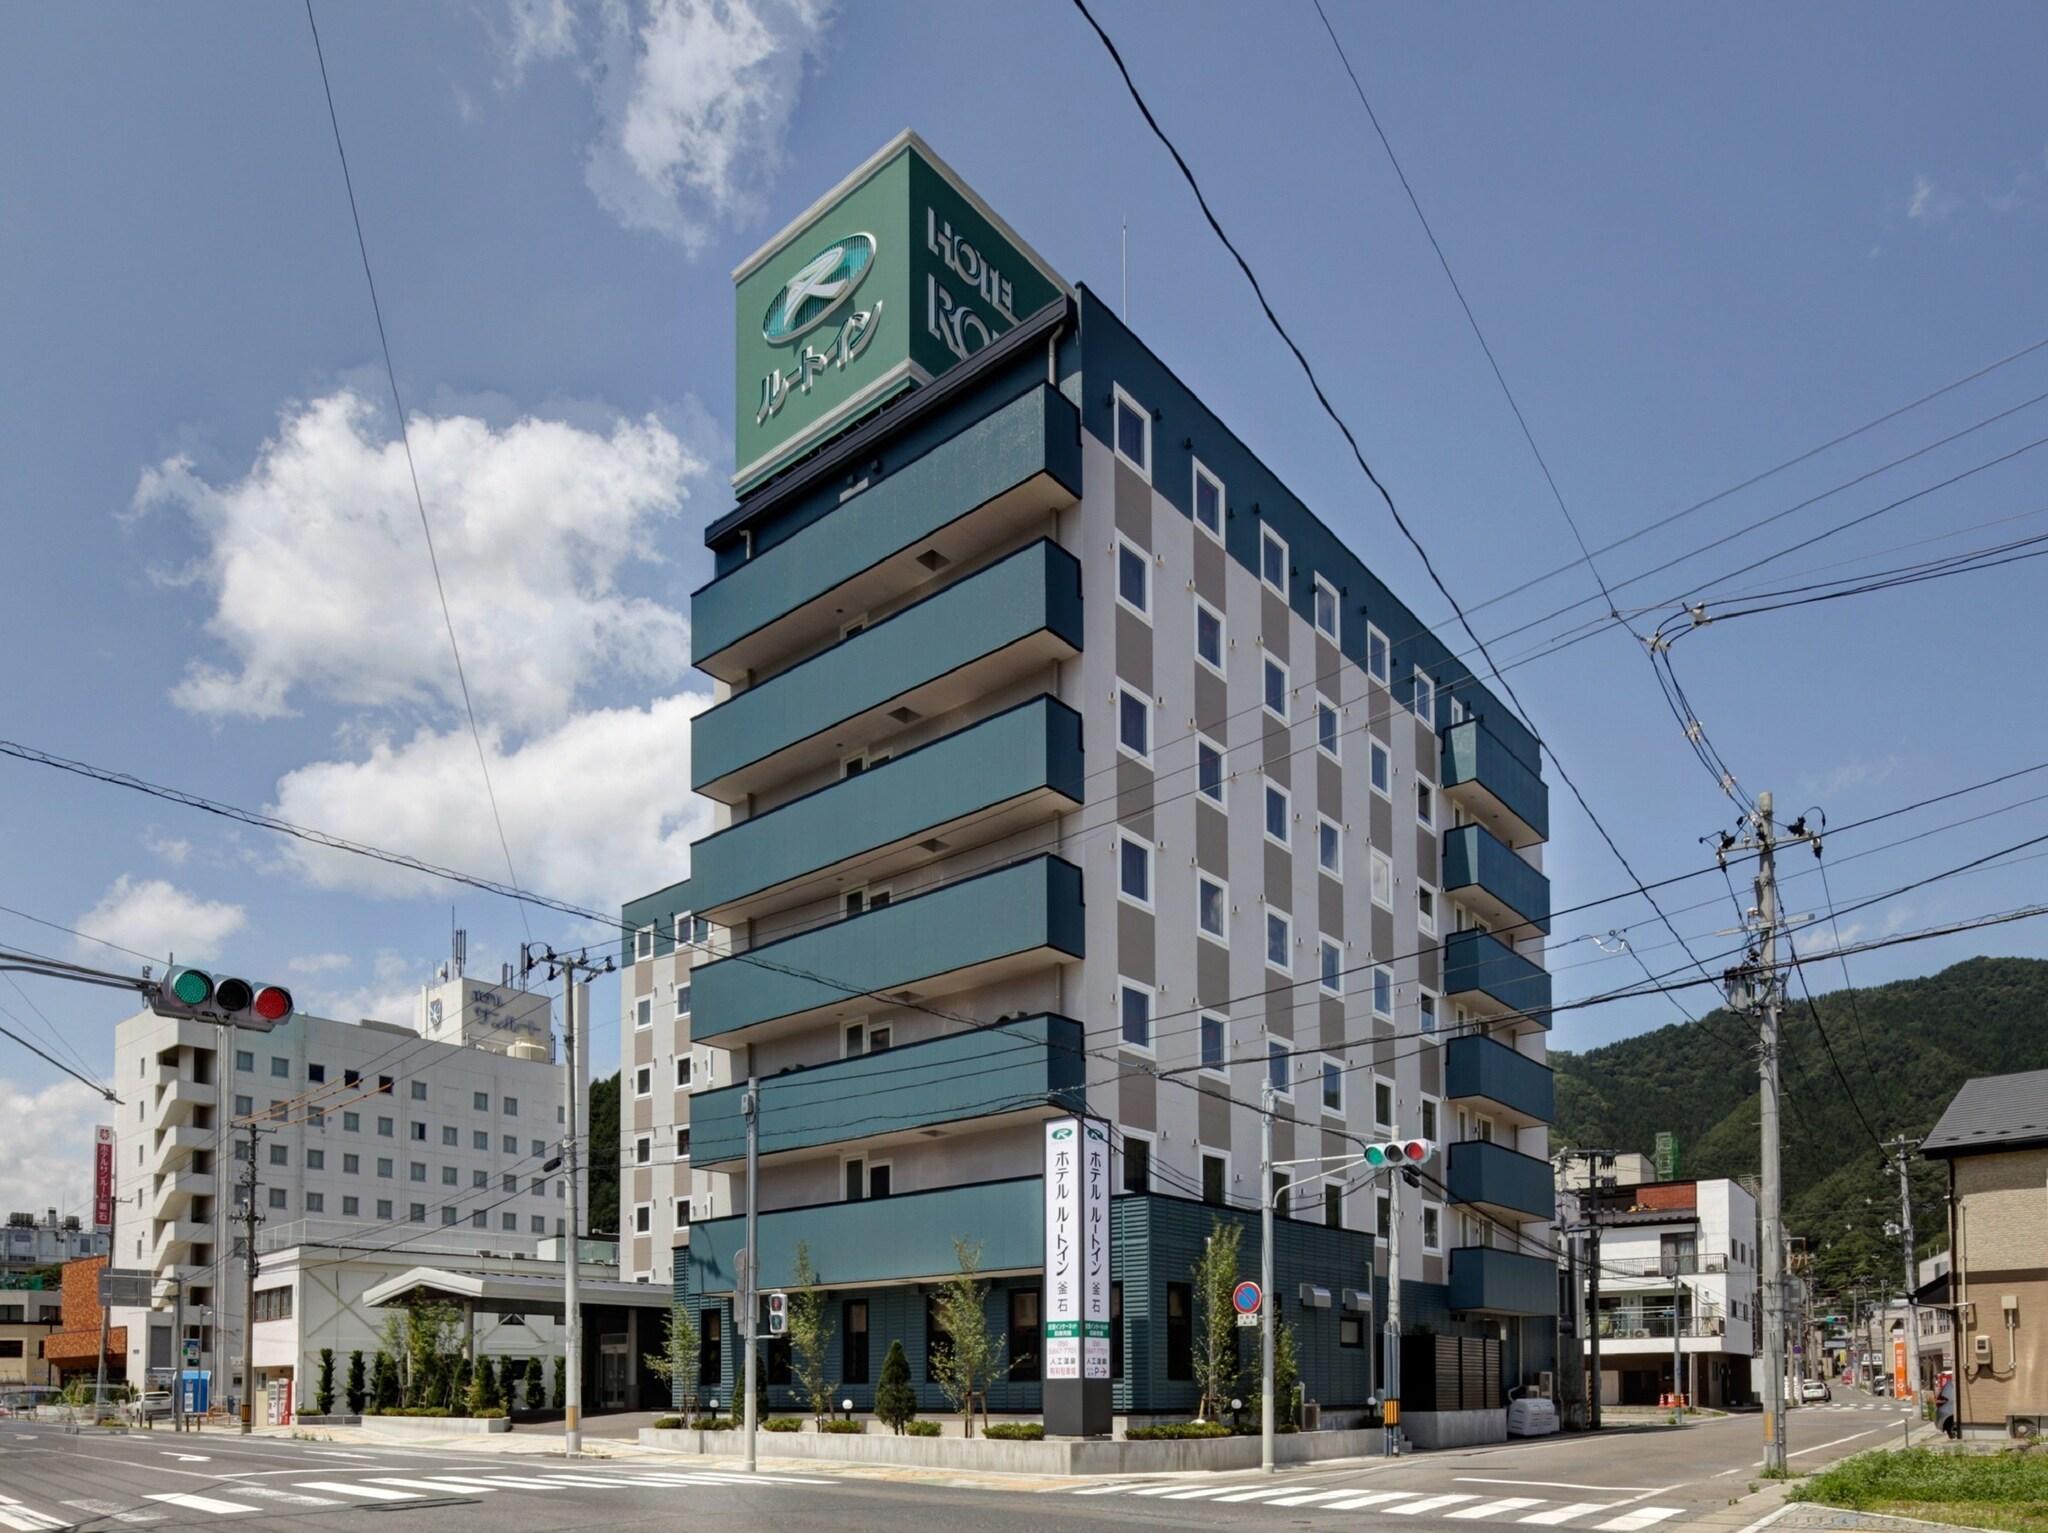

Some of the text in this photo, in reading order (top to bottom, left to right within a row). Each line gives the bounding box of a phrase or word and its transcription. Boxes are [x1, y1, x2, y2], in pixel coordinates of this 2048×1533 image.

[756, 299, 884, 425] ルートイン
[1055, 1150, 1070, 1200] ホテル
[1089, 1151, 1102, 1201] ホテル
[1056, 1206, 1070, 1277] ルートイン
[1090, 1206, 1102, 1277] ルートイン
